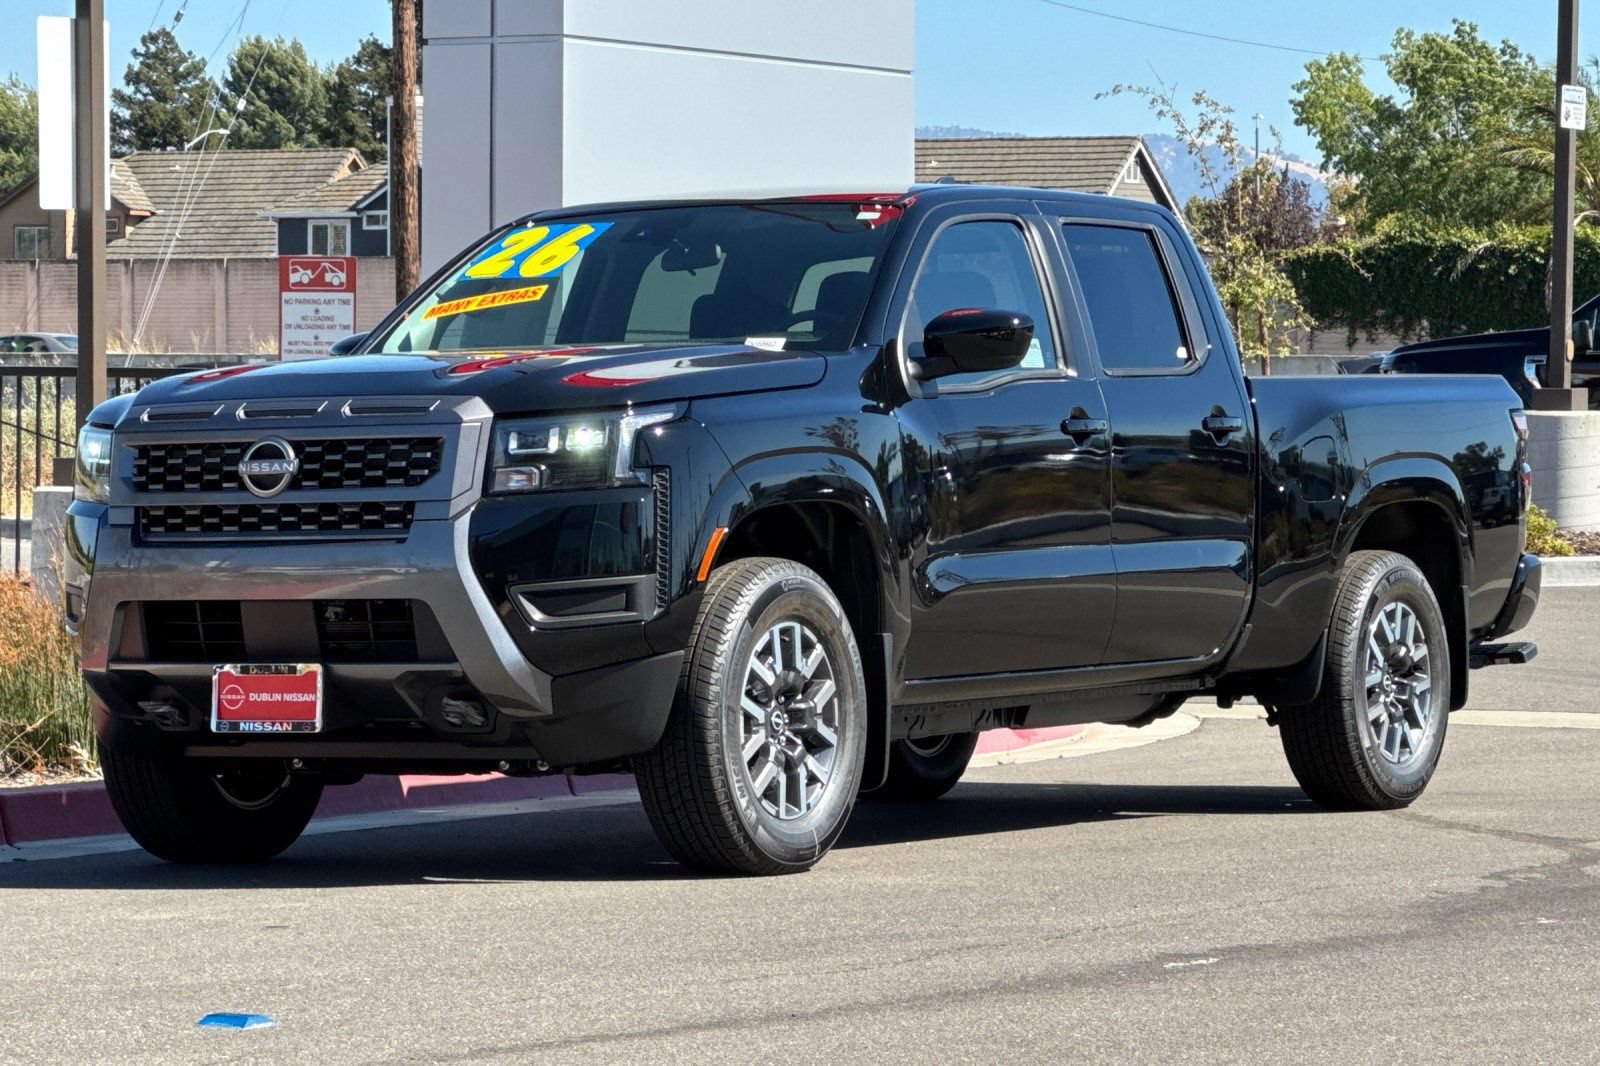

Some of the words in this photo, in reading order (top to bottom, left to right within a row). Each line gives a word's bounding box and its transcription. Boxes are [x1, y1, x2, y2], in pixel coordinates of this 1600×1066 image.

[465, 224, 596, 278] 26
[427, 301, 473, 317] MANY
[477, 287, 541, 305] EXTRAS
[239, 462, 294, 472] NISSAN
[249, 692, 282, 702] DUBLIN
[283, 692, 316, 702] NISSAN
[239, 722, 293, 731] NISSAN
